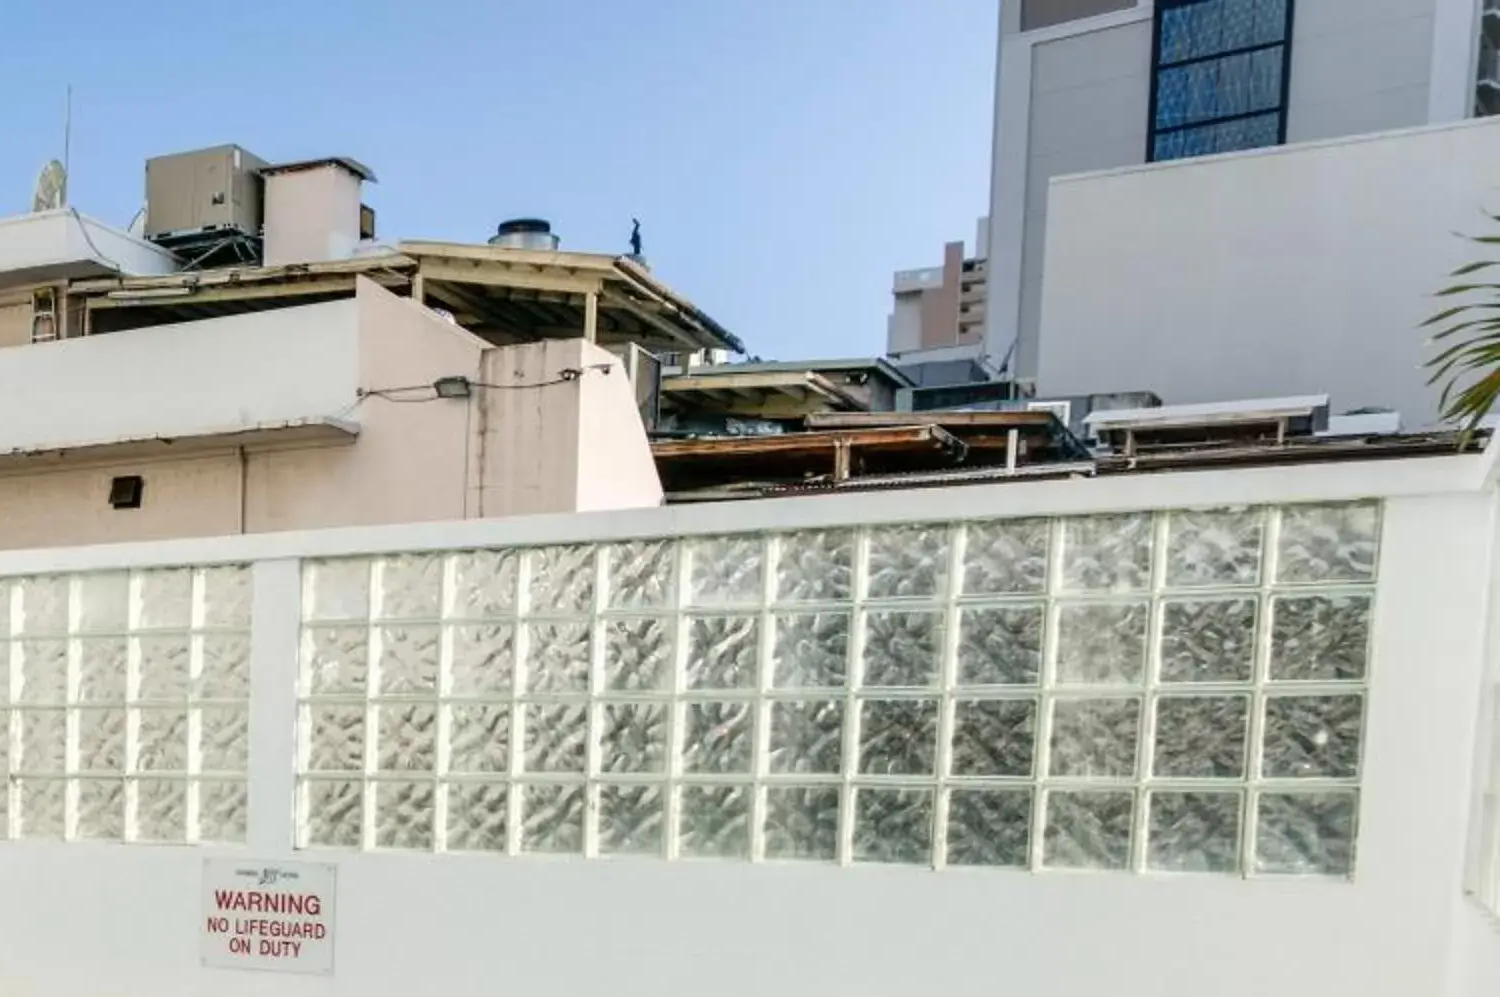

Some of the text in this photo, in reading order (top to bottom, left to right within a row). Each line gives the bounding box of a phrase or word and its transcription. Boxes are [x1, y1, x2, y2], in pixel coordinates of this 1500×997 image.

[215, 889, 321, 915] WARNING
[207, 917, 326, 940] NO LIFEGUARD
[229, 938, 301, 958] ON DUTY
